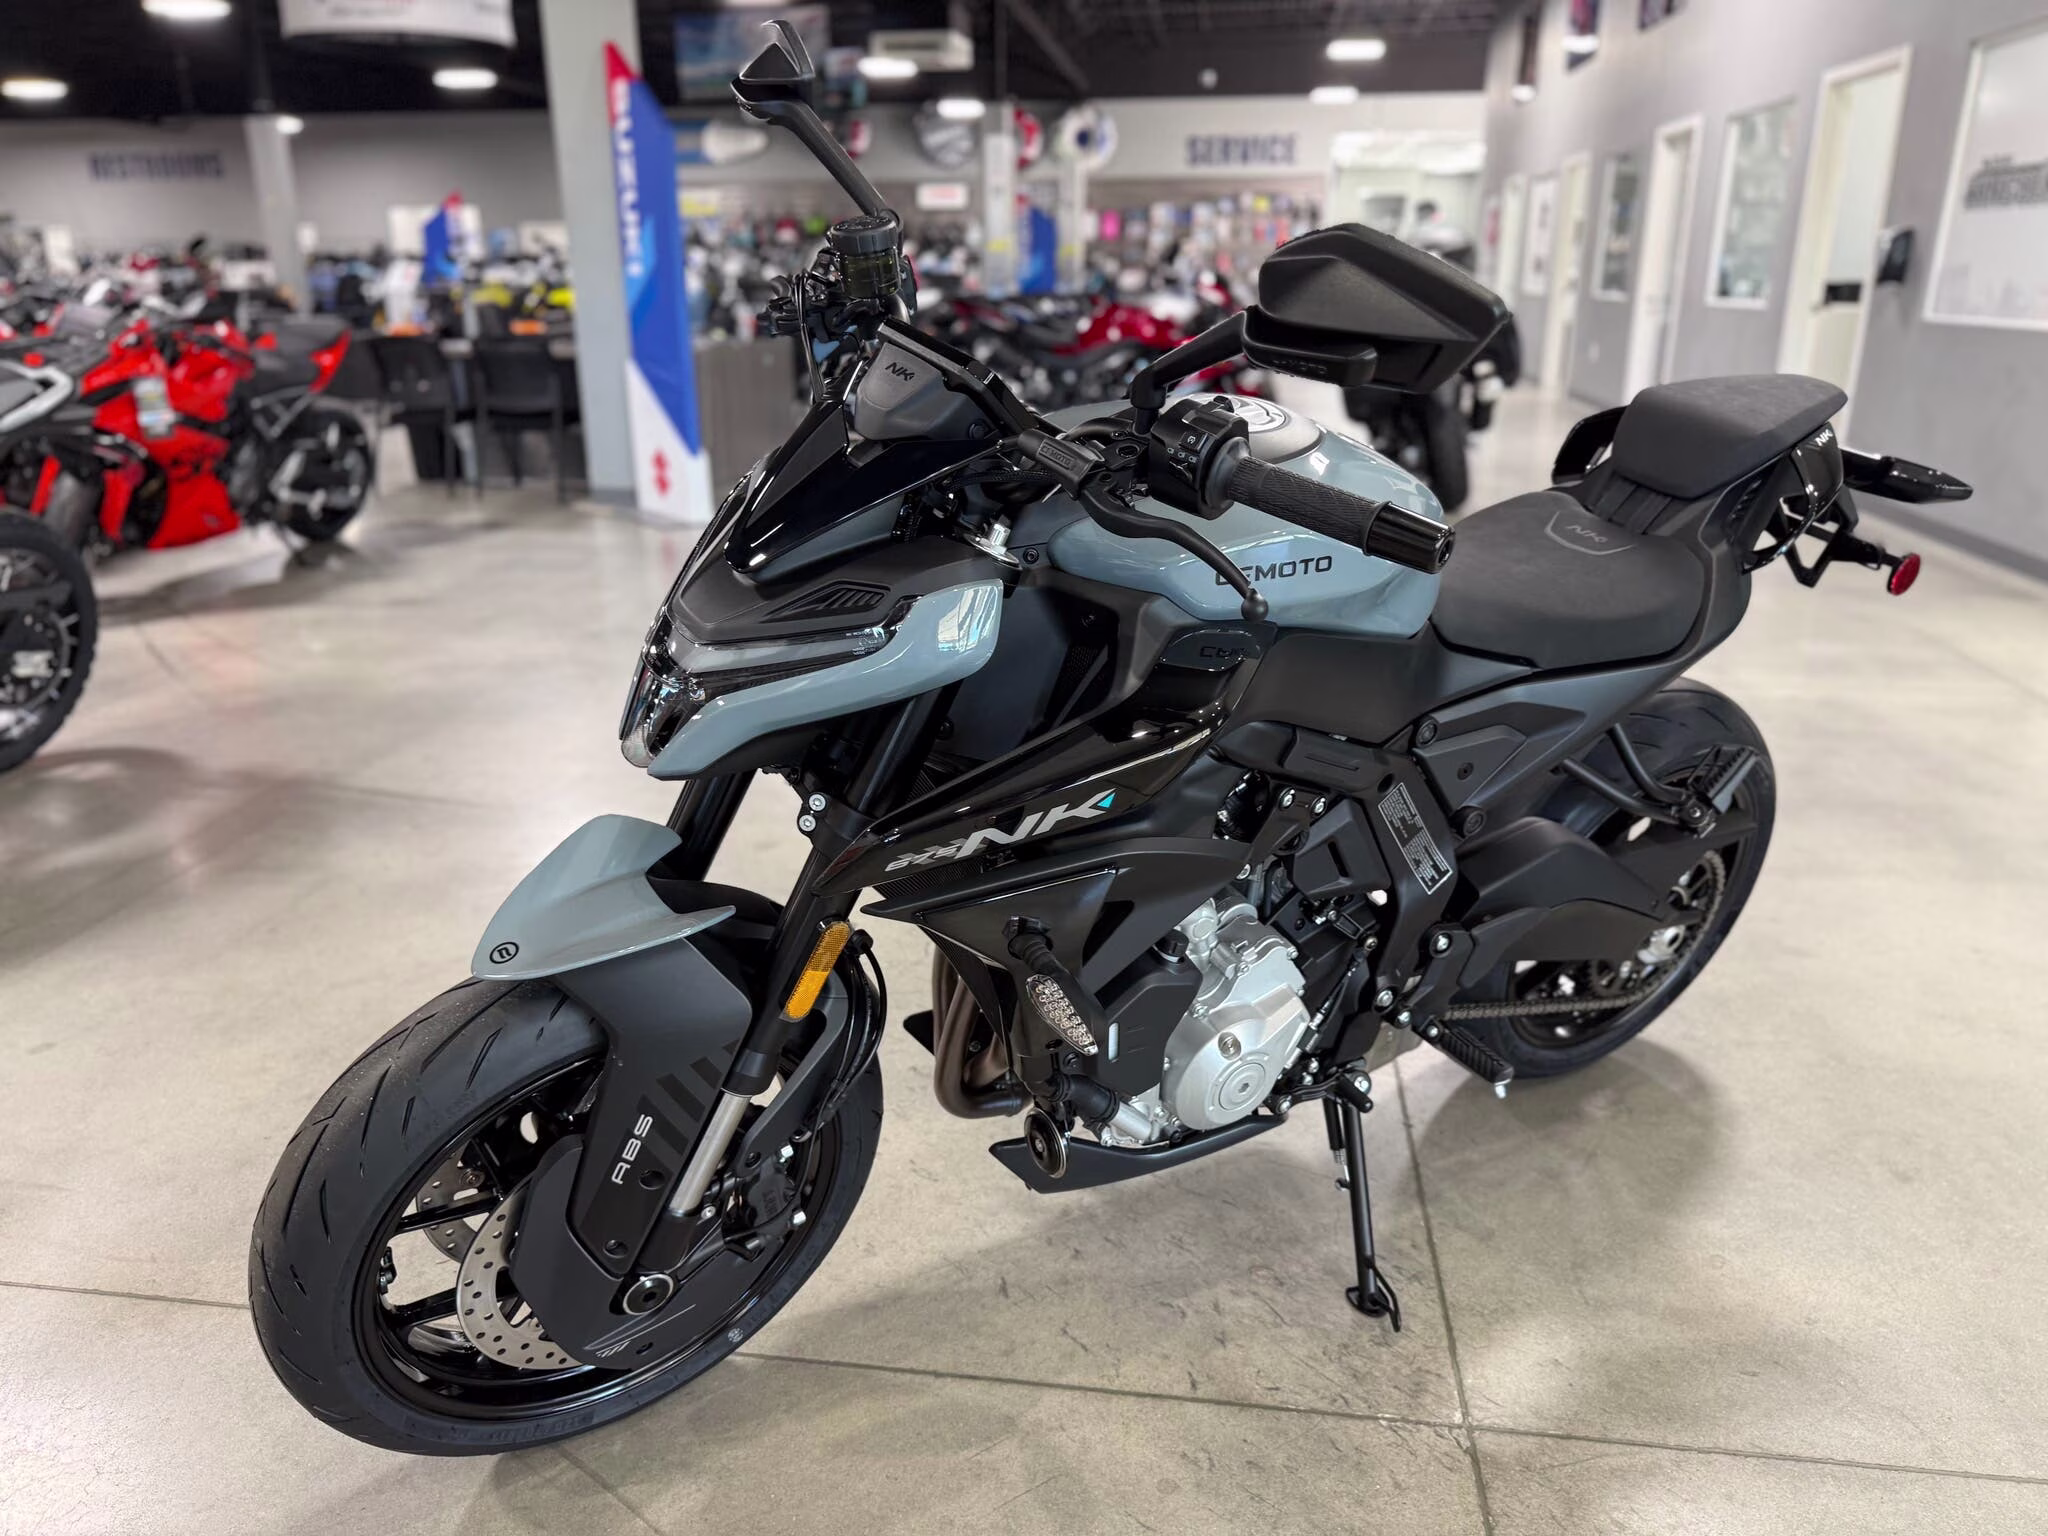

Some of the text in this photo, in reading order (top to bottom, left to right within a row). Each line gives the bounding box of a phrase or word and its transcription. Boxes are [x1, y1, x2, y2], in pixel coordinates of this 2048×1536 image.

[884, 361, 916, 382] NK
[1814, 429, 1833, 446] NK
[611, 1113, 654, 1185] ABS
